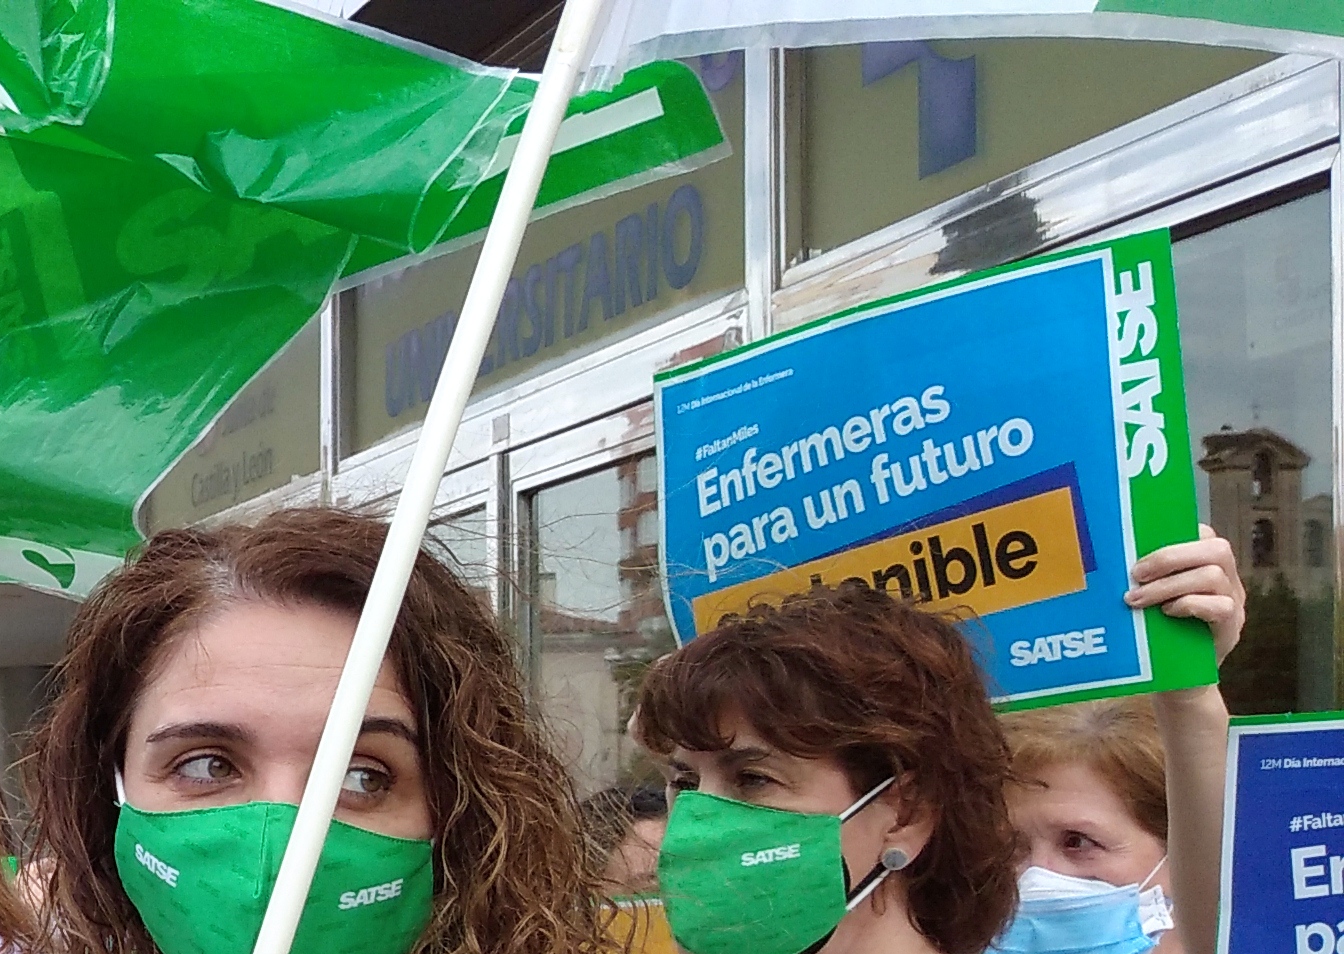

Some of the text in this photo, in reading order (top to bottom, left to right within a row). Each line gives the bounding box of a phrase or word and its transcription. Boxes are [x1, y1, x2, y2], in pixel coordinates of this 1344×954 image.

[384, 184, 705, 419] UNIRSITARIO
[1115, 260, 1169, 478] SATSE
[695, 423, 760, 461] #FaltanMiles
[696, 384, 951, 517] Enfermeras
[703, 416, 1035, 582] para un futuro
[1010, 626, 1108, 667] SATSE
[1260, 758, 1282, 770] 12M
[1283, 757, 1302, 769] Día
[1289, 812, 1344, 832] #Falta
[134, 843, 179, 889] SATSE
[740, 843, 801, 867] SATSE
[338, 878, 404, 911] SATSE
